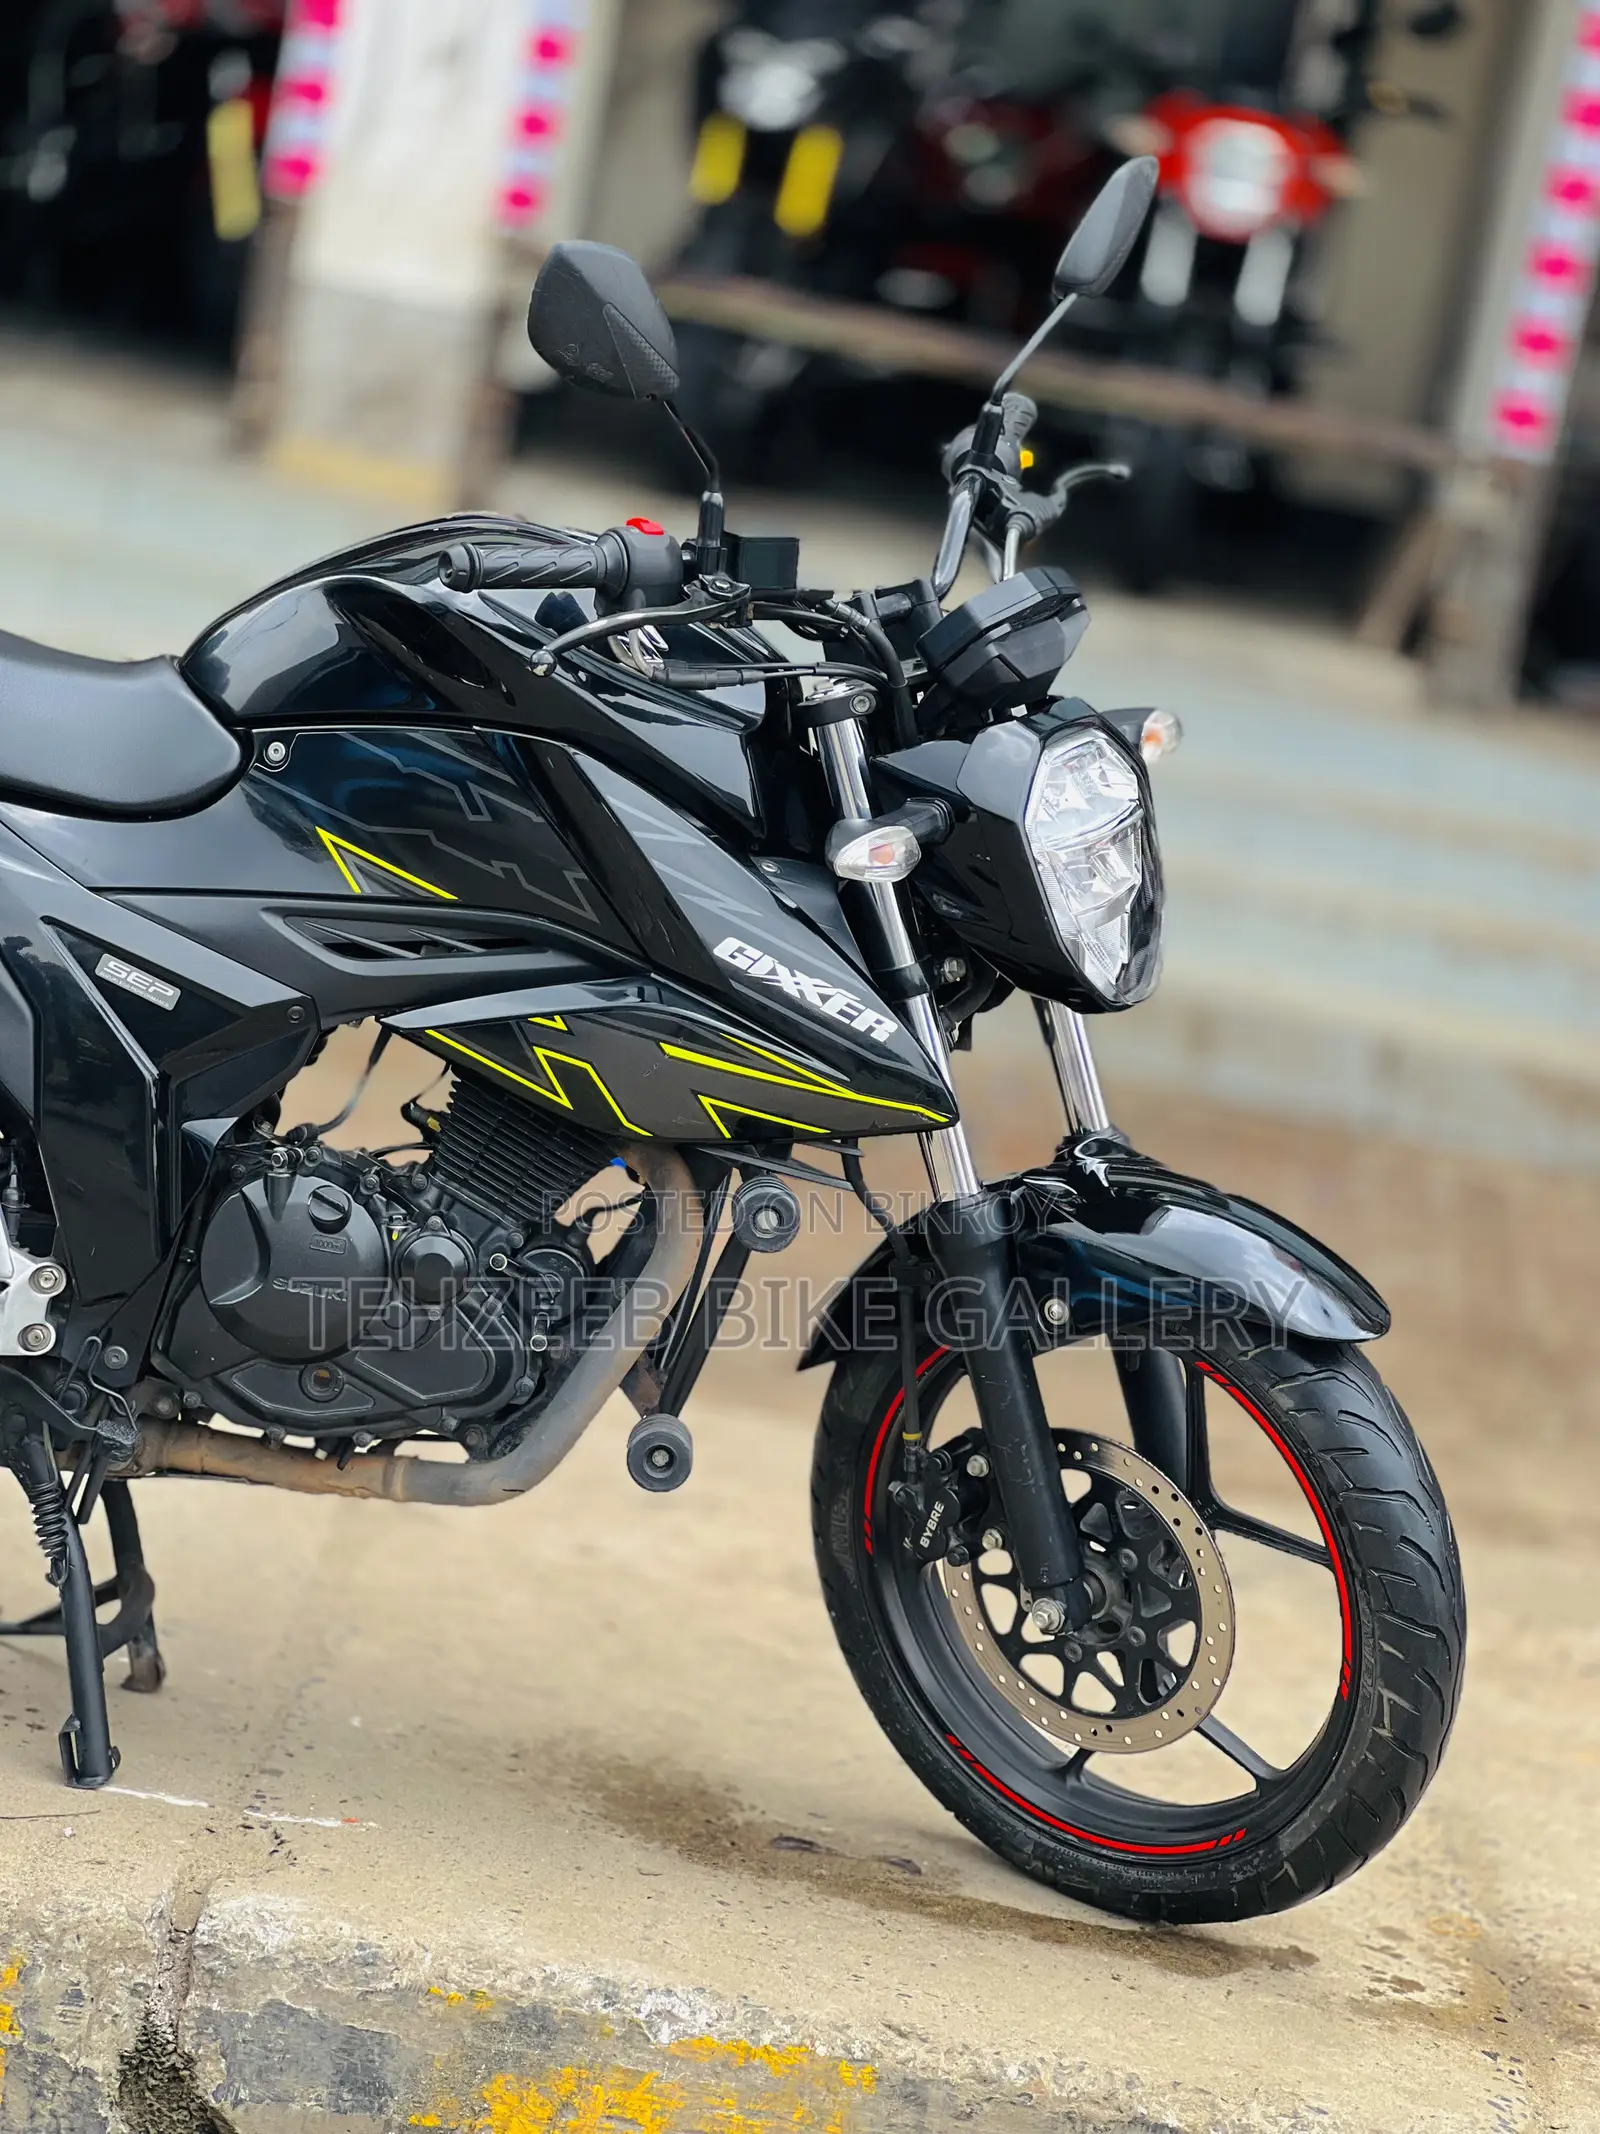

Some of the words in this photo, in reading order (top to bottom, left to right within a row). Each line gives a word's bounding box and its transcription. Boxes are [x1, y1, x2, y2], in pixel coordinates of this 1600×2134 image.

[103, 960, 174, 997] SEP
[713, 937, 898, 1043] GIXXER
[272, 1277, 347, 1302] SUZUKI
[919, 1500, 945, 1549] BYBRE
